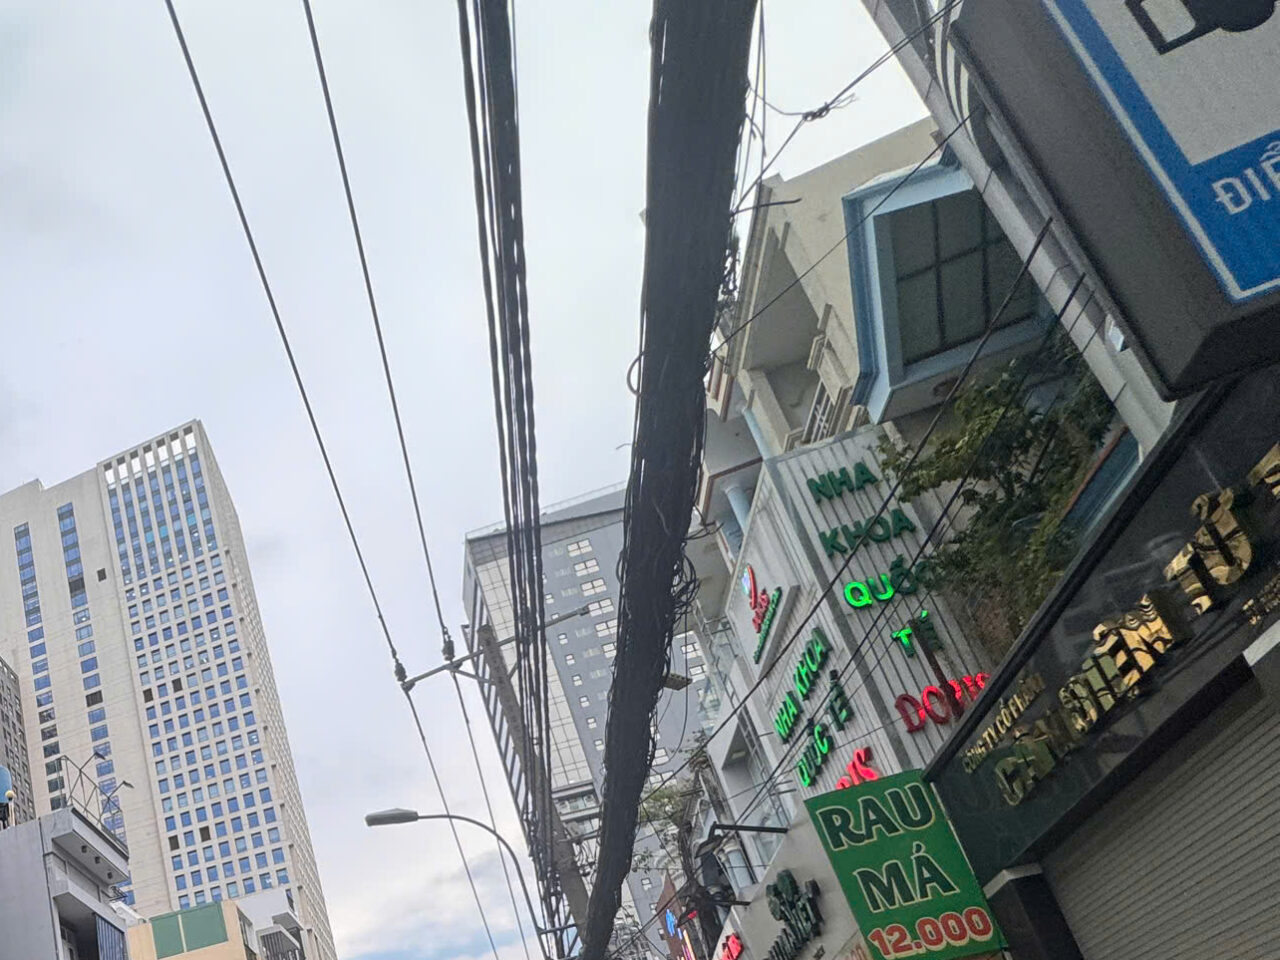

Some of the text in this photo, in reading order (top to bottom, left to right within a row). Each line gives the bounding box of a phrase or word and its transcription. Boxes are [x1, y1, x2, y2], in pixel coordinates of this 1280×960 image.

[806, 461, 879, 501] NHA
[819, 508, 916, 557] KHOA
[774, 691, 803, 744] NHA
[816, 783, 935, 851] RAU
[853, 841, 960, 913] MÁ
[868, 907, 993, 959] 12.000
